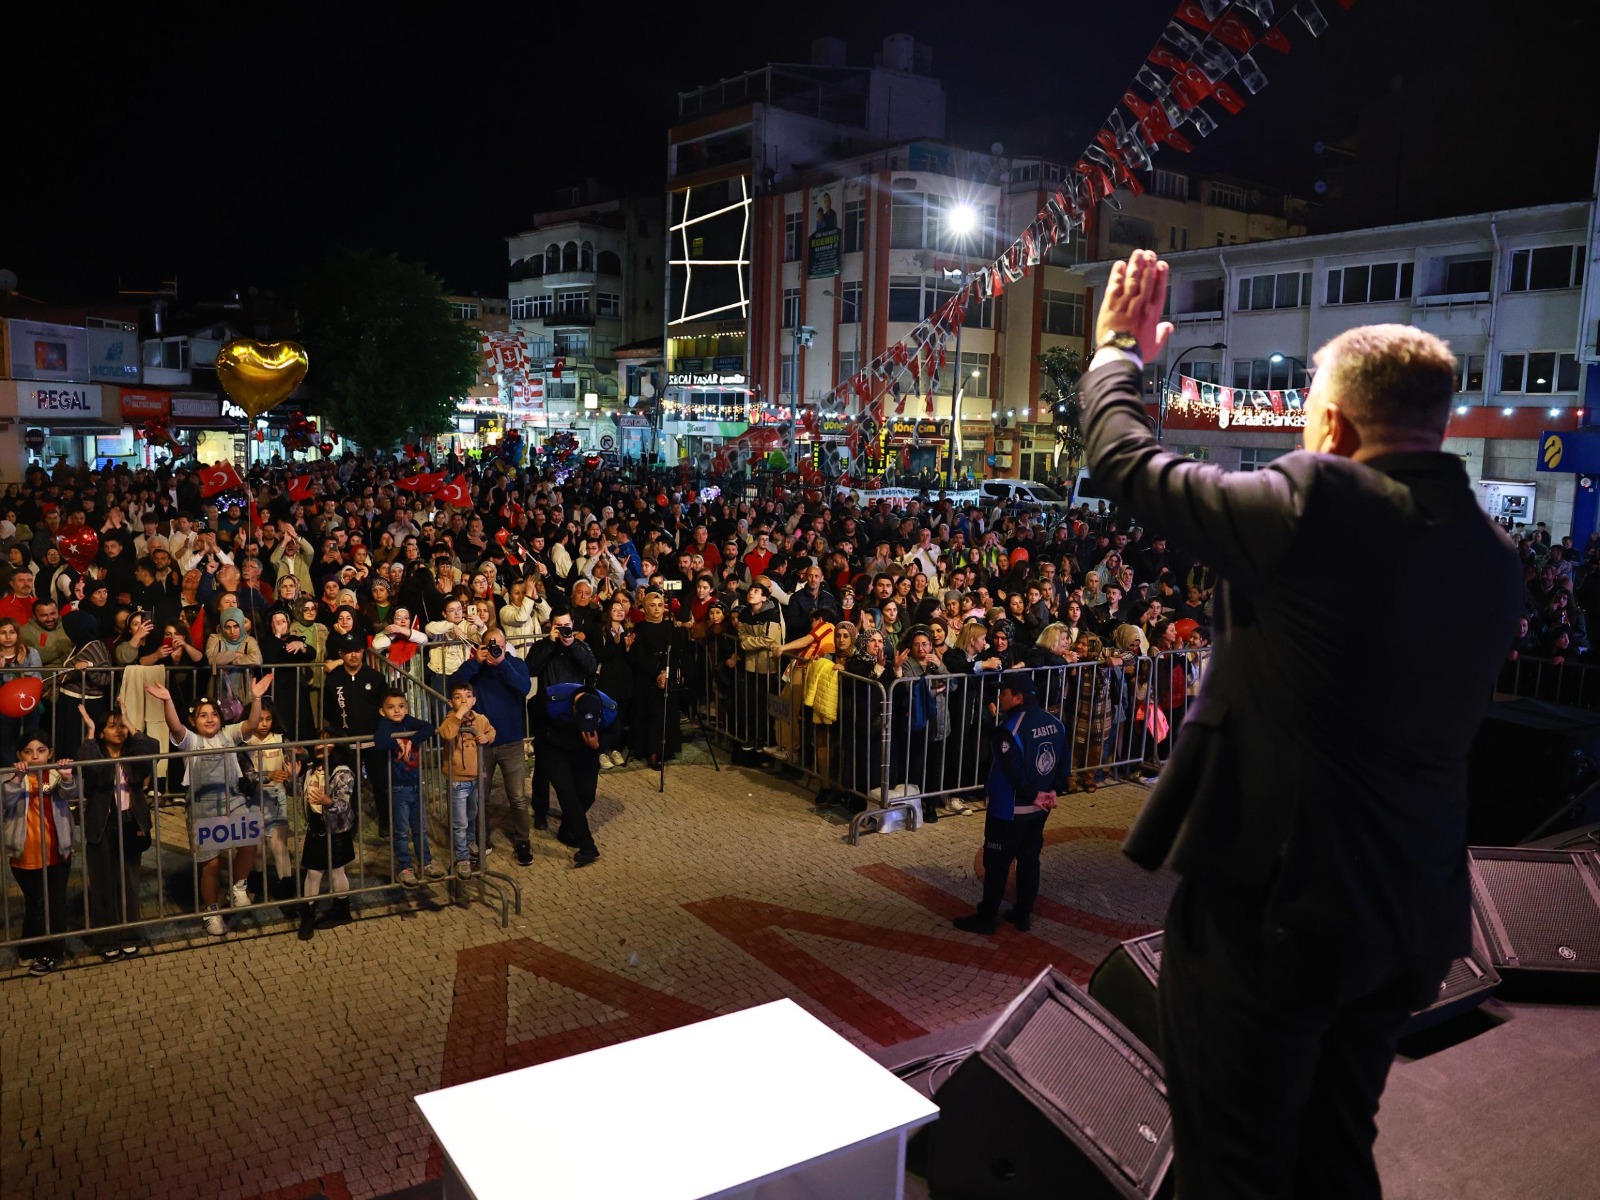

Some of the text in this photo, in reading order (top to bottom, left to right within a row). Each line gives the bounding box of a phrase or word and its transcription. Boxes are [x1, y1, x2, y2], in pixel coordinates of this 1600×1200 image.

[37, 390, 91, 410] REGAL
[1266, 412, 1309, 426] Bankas
[893, 422, 936, 433] dönecim
[1031, 724, 1059, 739] ZABITA
[198, 816, 260, 845] POLİS
